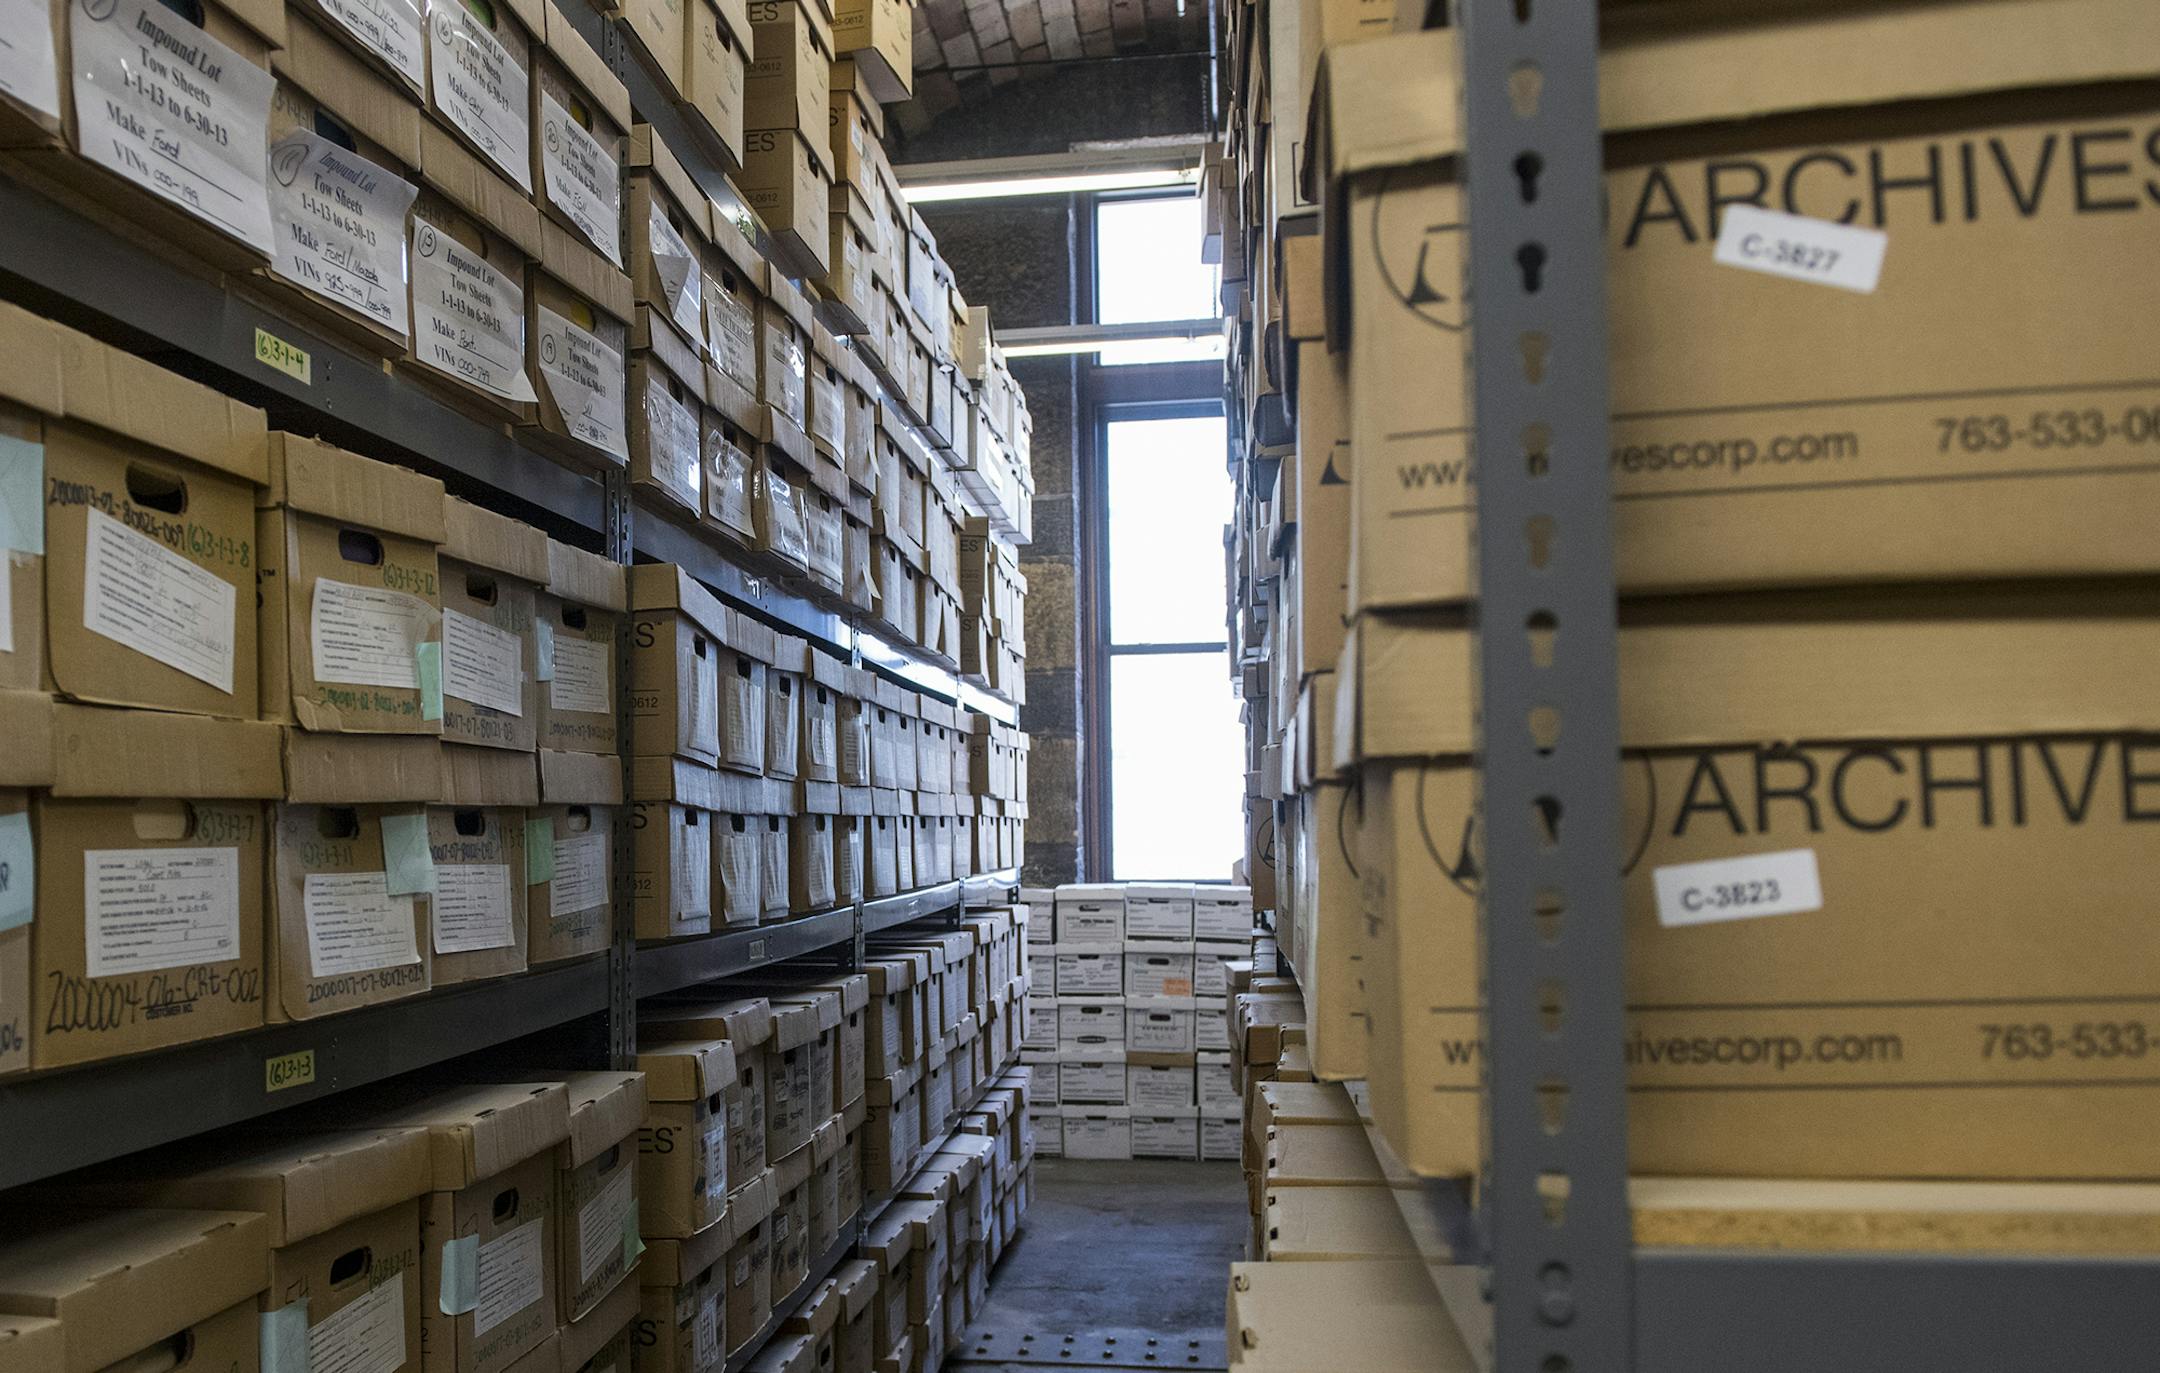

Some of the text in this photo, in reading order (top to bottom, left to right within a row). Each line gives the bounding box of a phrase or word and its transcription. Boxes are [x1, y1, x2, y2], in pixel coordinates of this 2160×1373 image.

[135, 9, 197, 70] Impound
[198, 49, 223, 83] Lot
[461, 12, 505, 68] Impound Lot
[138, 46, 212, 108] Tow Sheets
[447, 72, 468, 103] Make
[482, 54, 502, 85] Sheets
[123, 70, 229, 147] 1-1-13 to 6-30-13
[106, 100, 180, 159] Make Ford
[113, 138, 149, 177] VINs
[319, 151, 377, 195] Impound Lot
[313, 173, 364, 217] Tow Sheets
[1623, 127, 2160, 249] ARCHIVE
[291, 223, 320, 253] Make
[302, 193, 377, 247] 1-1-13 to 6-30-13
[294, 255, 321, 283] VINs
[446, 248, 496, 287] Impound Lot
[1738, 231, 1841, 273] C-3827
[451, 273, 492, 308] Tow Sheets
[432, 317, 456, 341] Make
[441, 290, 501, 333] 1-1-13 to 6-30-13
[434, 344, 456, 368] VINs
[1680, 878, 1782, 912] C-3823
[268, 1055, 312, 1085] (6)3-1-3
